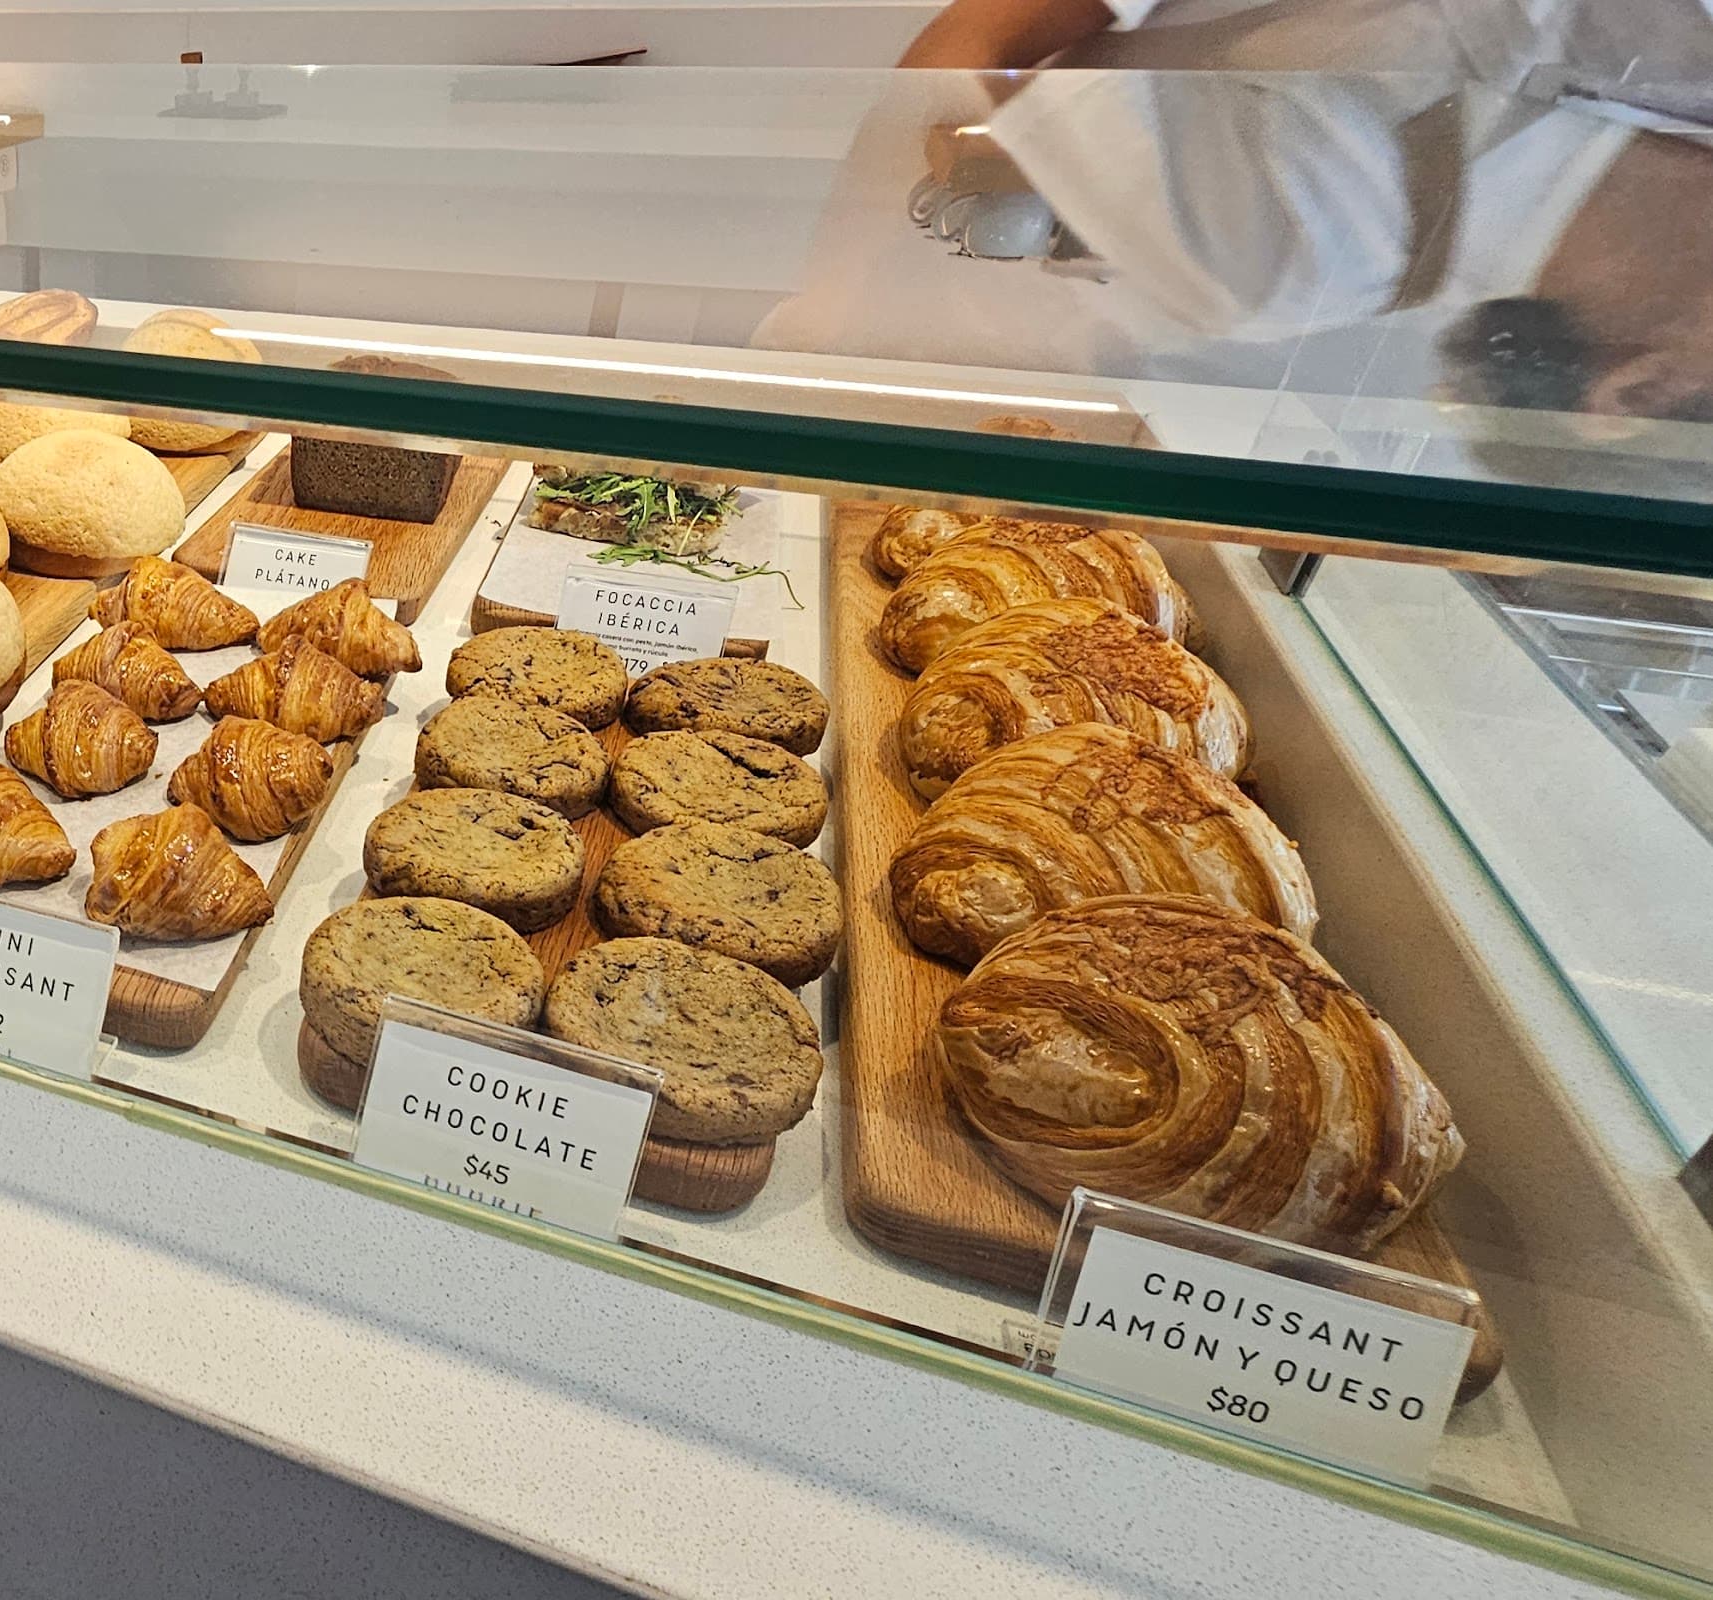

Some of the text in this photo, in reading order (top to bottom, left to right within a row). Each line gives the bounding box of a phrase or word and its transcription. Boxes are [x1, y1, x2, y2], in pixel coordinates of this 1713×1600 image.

[275, 548, 317, 566] CAKE
[255, 568, 330, 591] PLÁTANO
[595, 589, 697, 616] FOCACCIA
[598, 612, 680, 636] IBÉRICA
[621, 656, 648, 673] 179
[447, 1065, 569, 1119] COOKIE
[402, 1094, 597, 1171] CHOCOLATE
[463, 1154, 510, 1185] $45
[1143, 1271, 1404, 1364] CROISSANT
[1072, 1301, 1221, 1362] JAMÓN
[1236, 1345, 1261, 1372] Y
[1273, 1359, 1425, 1423] QUESO
[1206, 1385, 1271, 1426] $80
